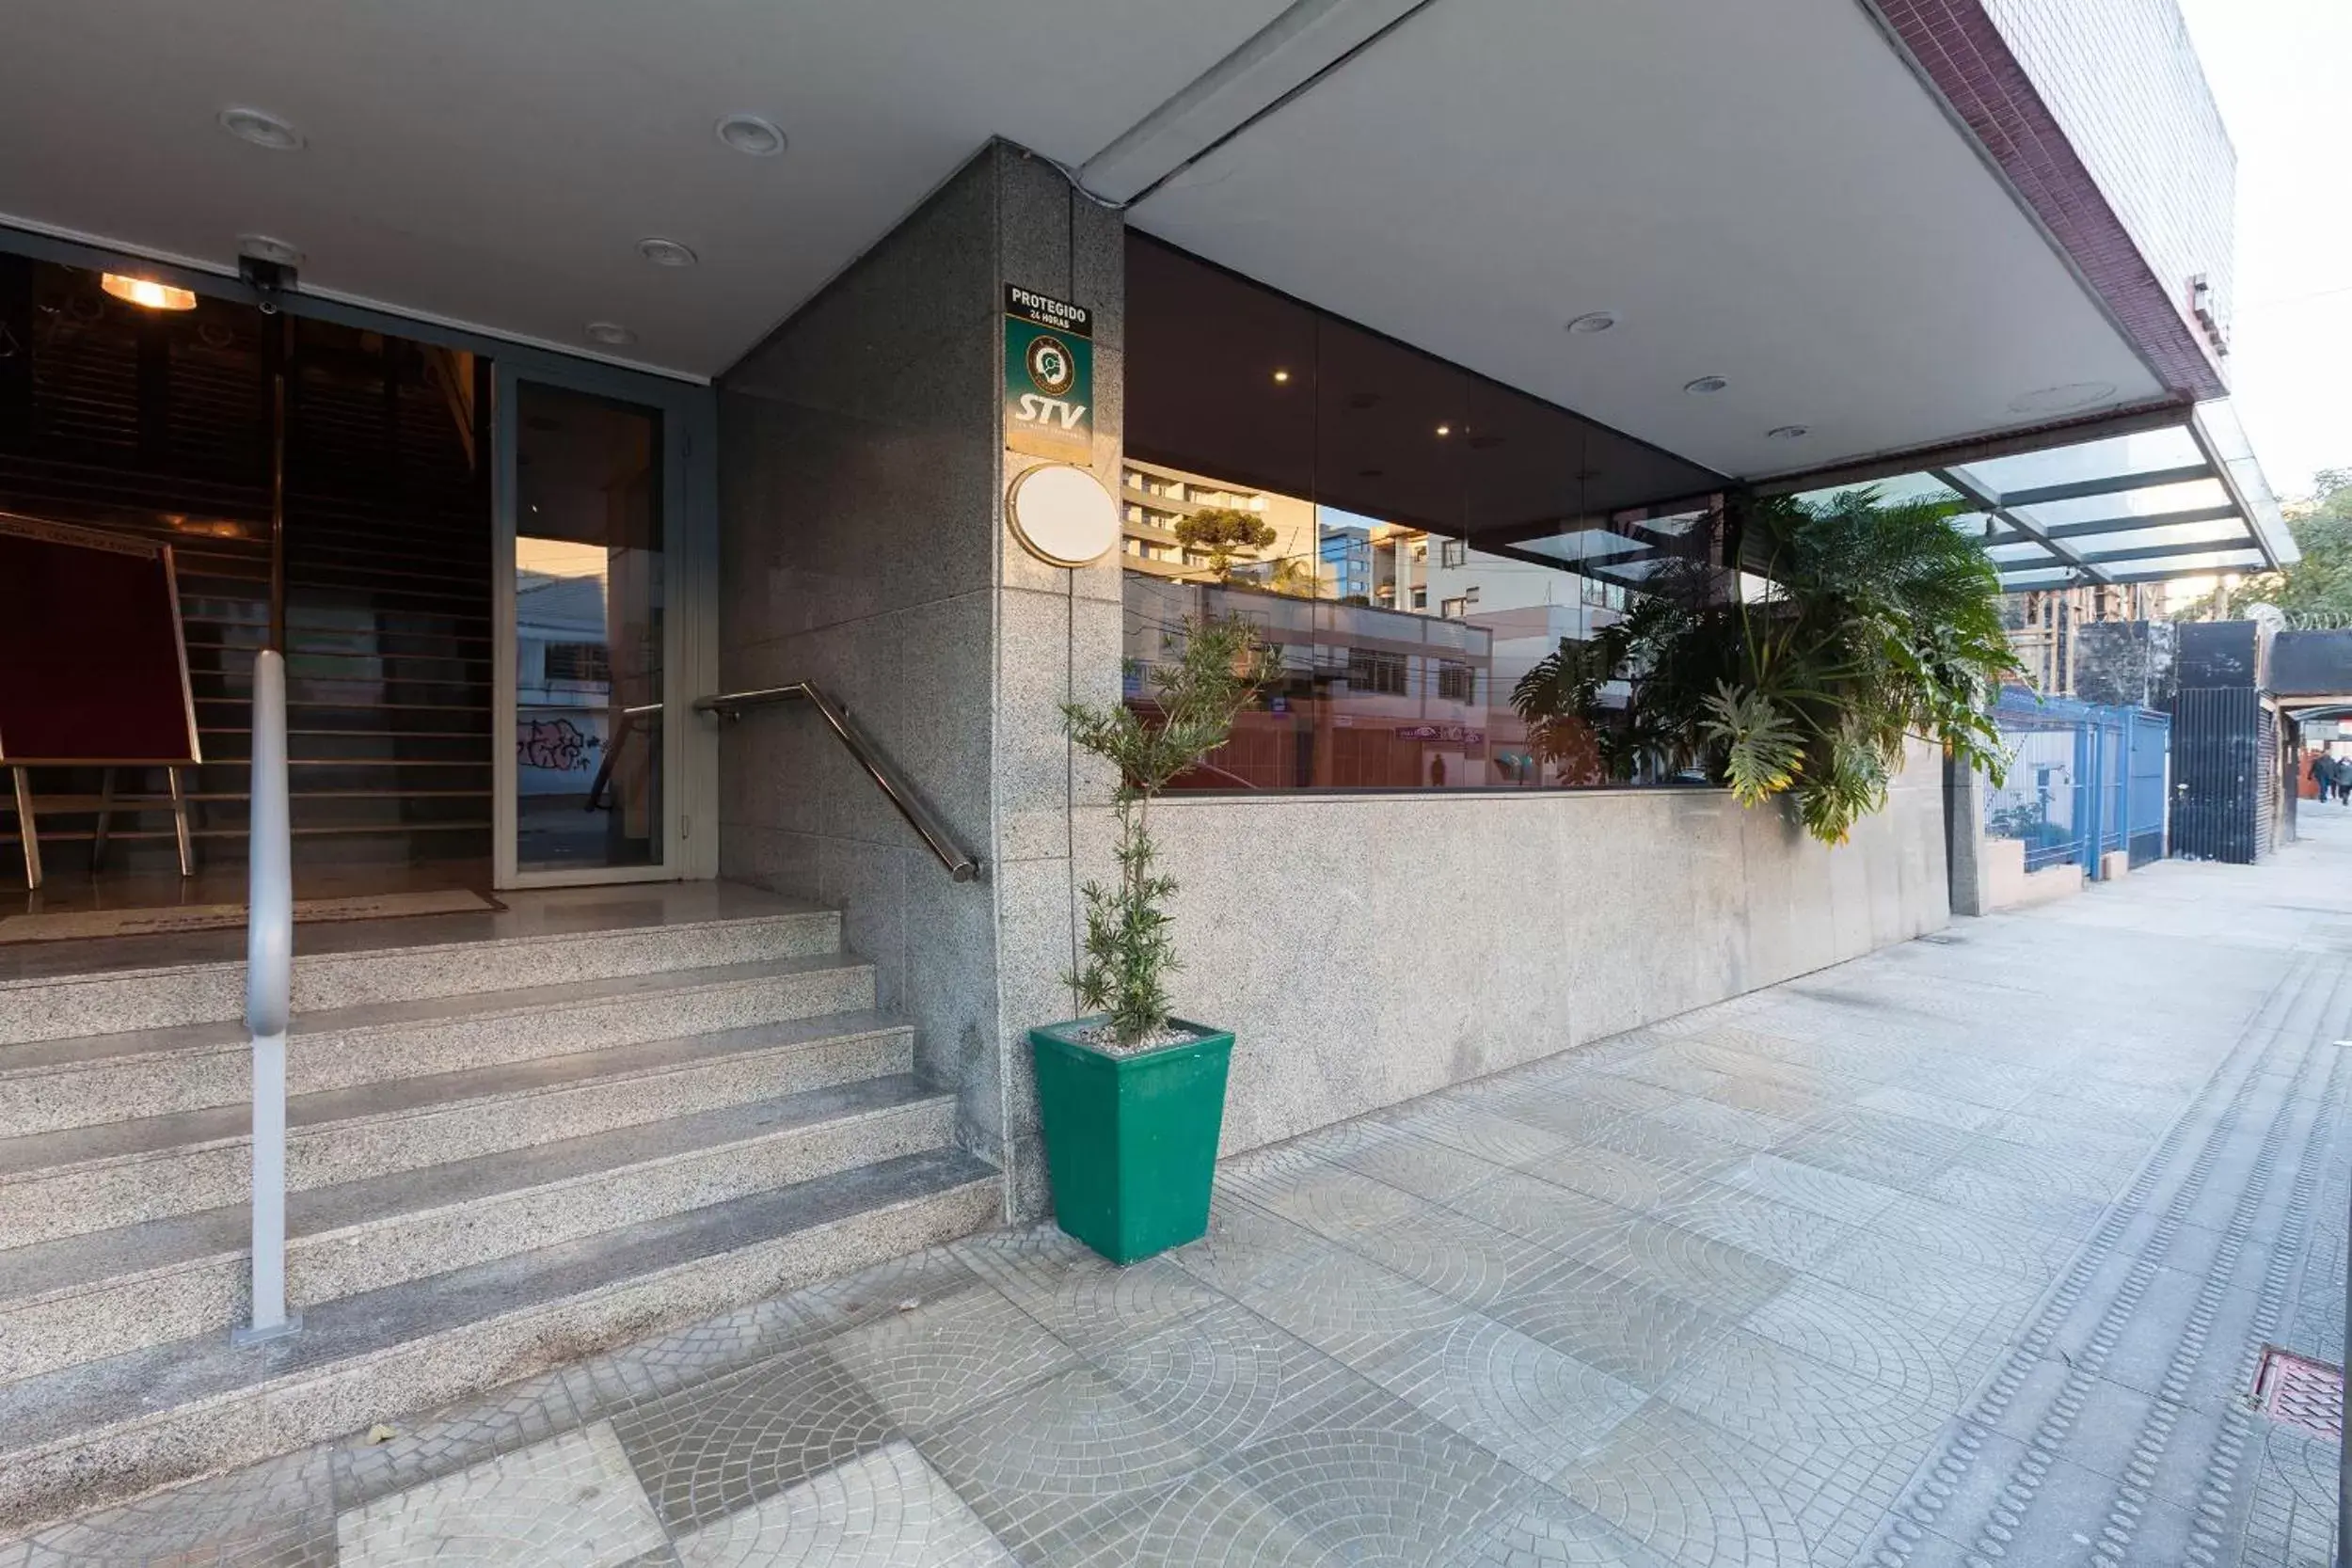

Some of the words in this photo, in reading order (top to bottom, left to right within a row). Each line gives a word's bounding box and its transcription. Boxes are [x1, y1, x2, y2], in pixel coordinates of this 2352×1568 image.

[1012, 288, 1086, 323] PROTEGIDO
[1030, 309, 1041, 320] 24
[1042, 313, 1070, 329] HORAS
[1015, 393, 1087, 430] STV
